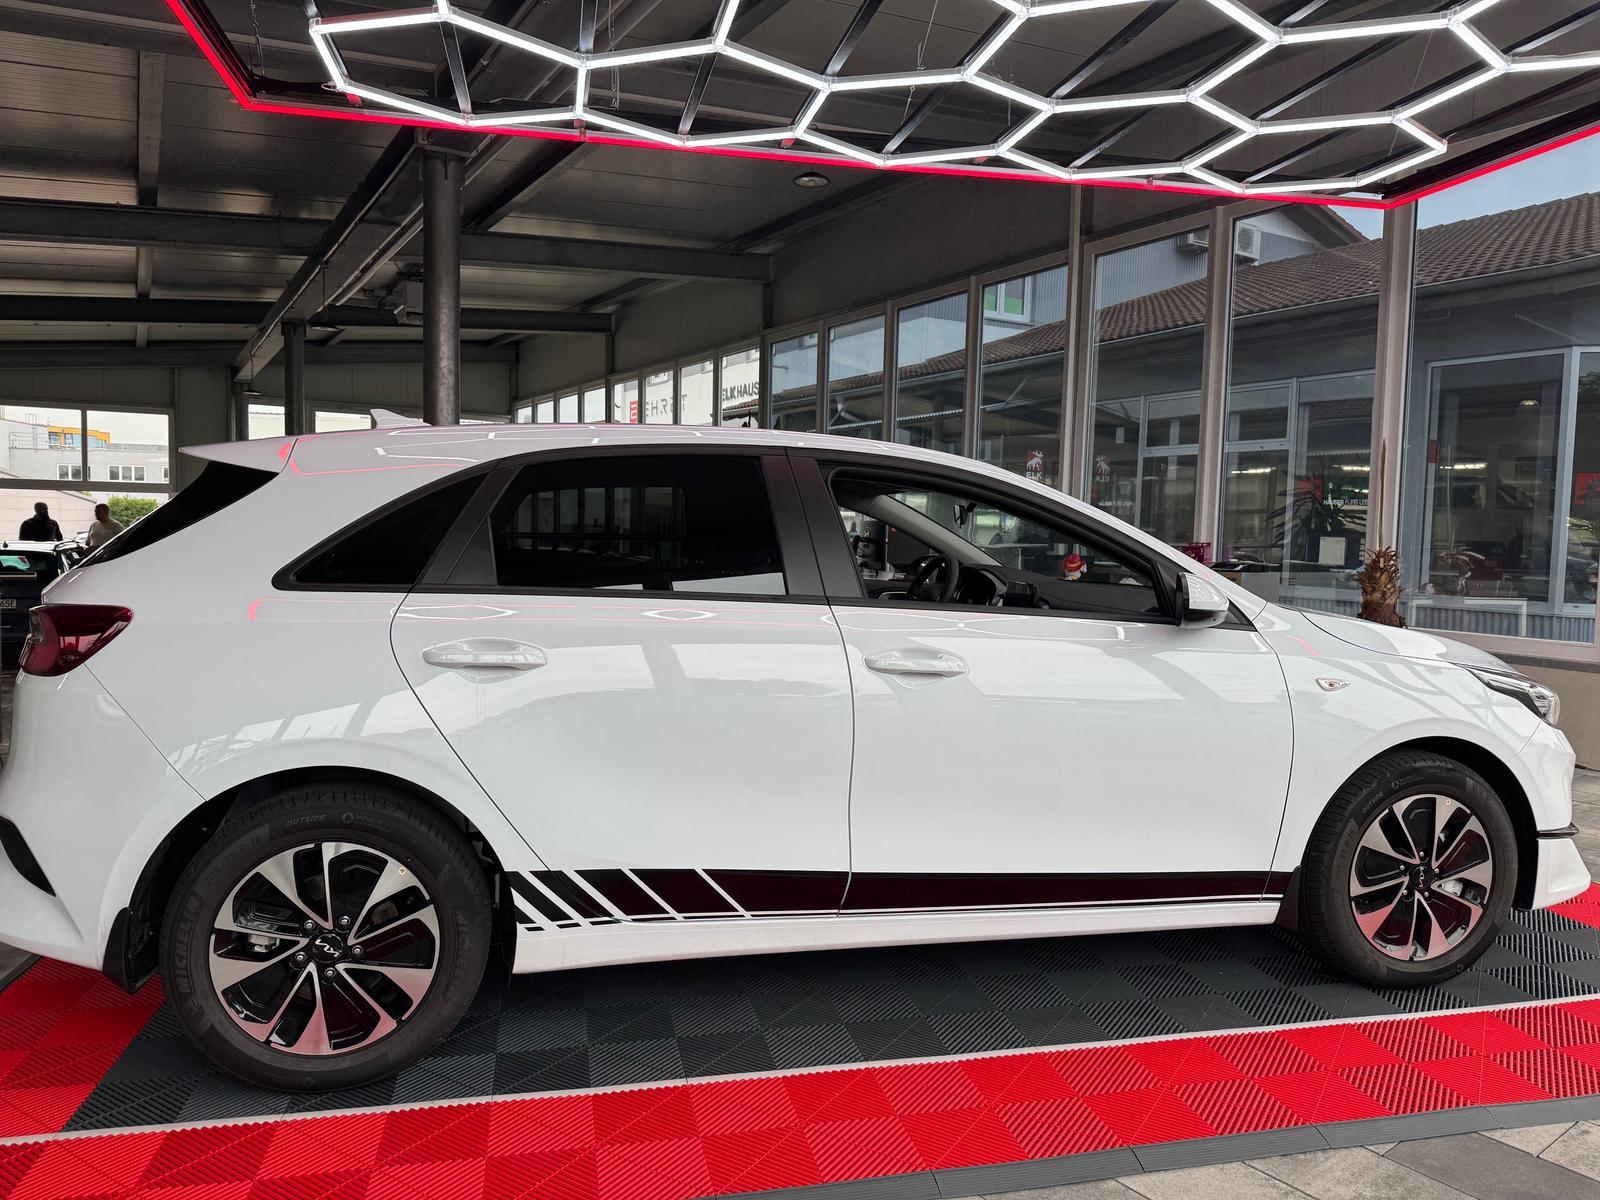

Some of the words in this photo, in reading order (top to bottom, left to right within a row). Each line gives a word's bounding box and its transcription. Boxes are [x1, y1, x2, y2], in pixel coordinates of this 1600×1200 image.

[1026, 471, 1042, 479] ELK
[286, 814, 327, 827] OUTSIDE
[174, 891, 202, 993] MICHELIN
